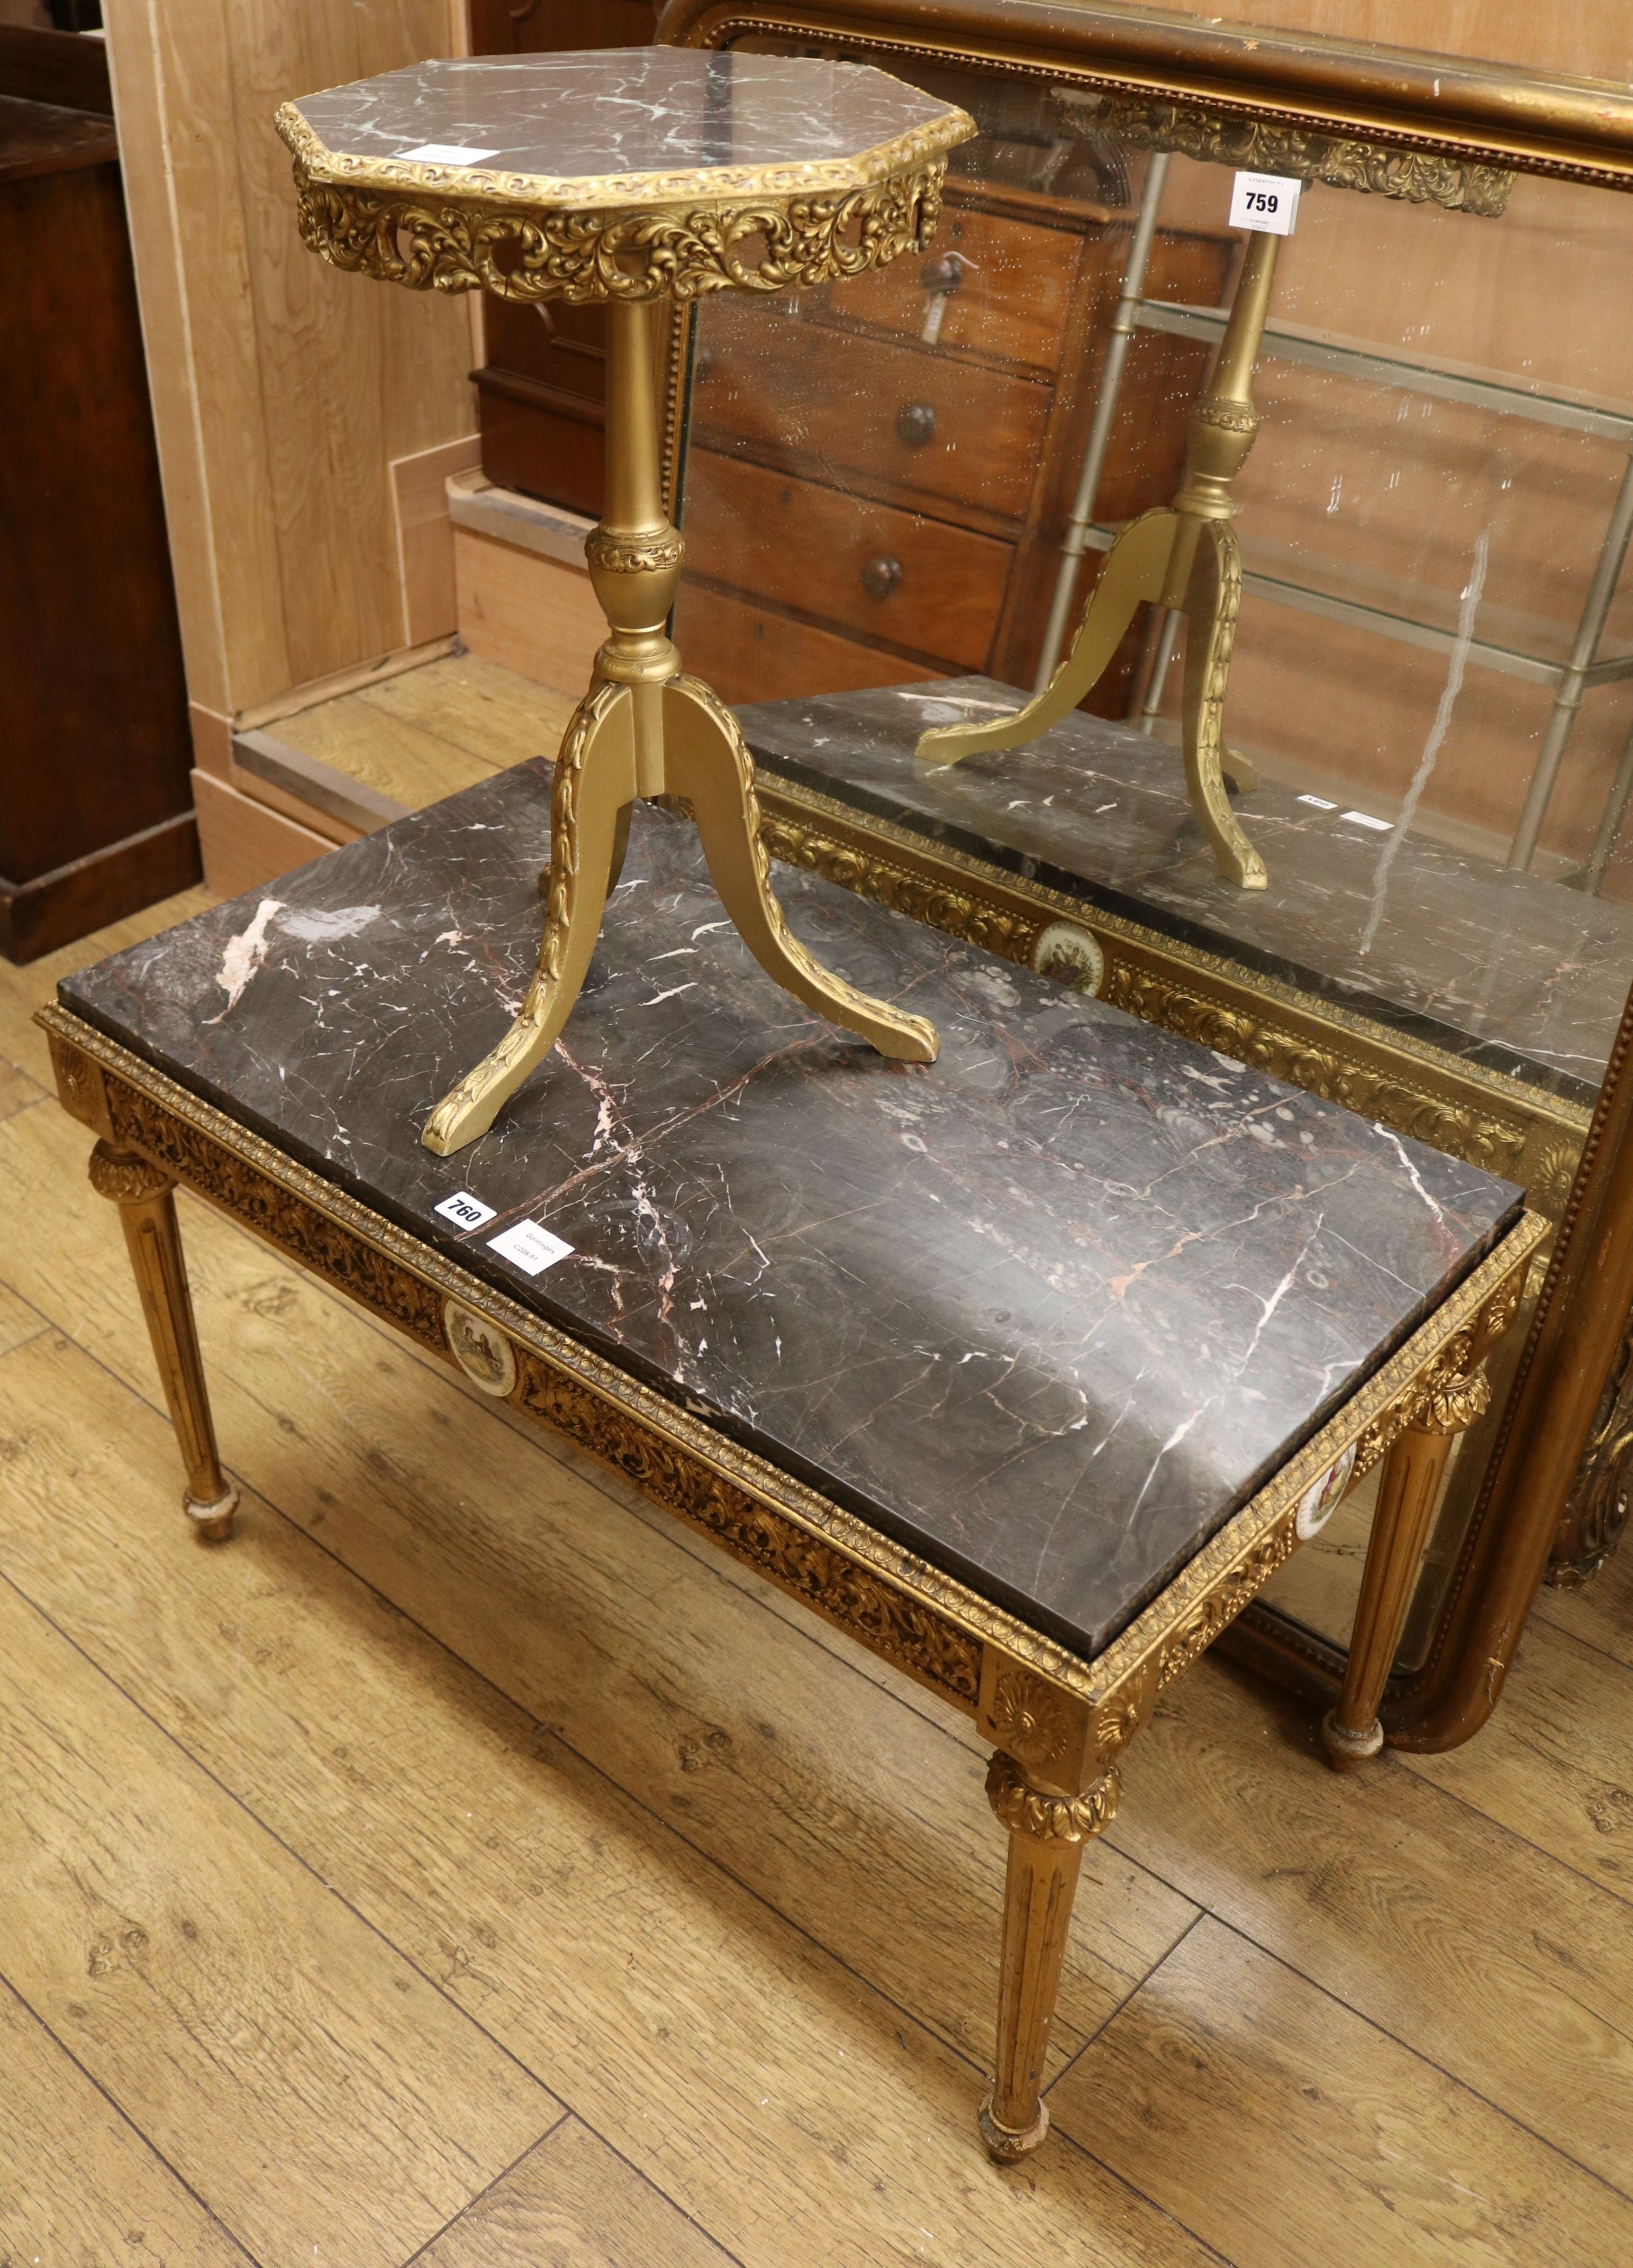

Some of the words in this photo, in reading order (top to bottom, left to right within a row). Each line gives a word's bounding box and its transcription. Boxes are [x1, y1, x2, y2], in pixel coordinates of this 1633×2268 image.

[1246, 192, 1278, 213] 759
[448, 1199, 482, 1222] 760
[513, 1244, 538, 1261] C208/51
[525, 1233, 556, 1254] Gorringes
